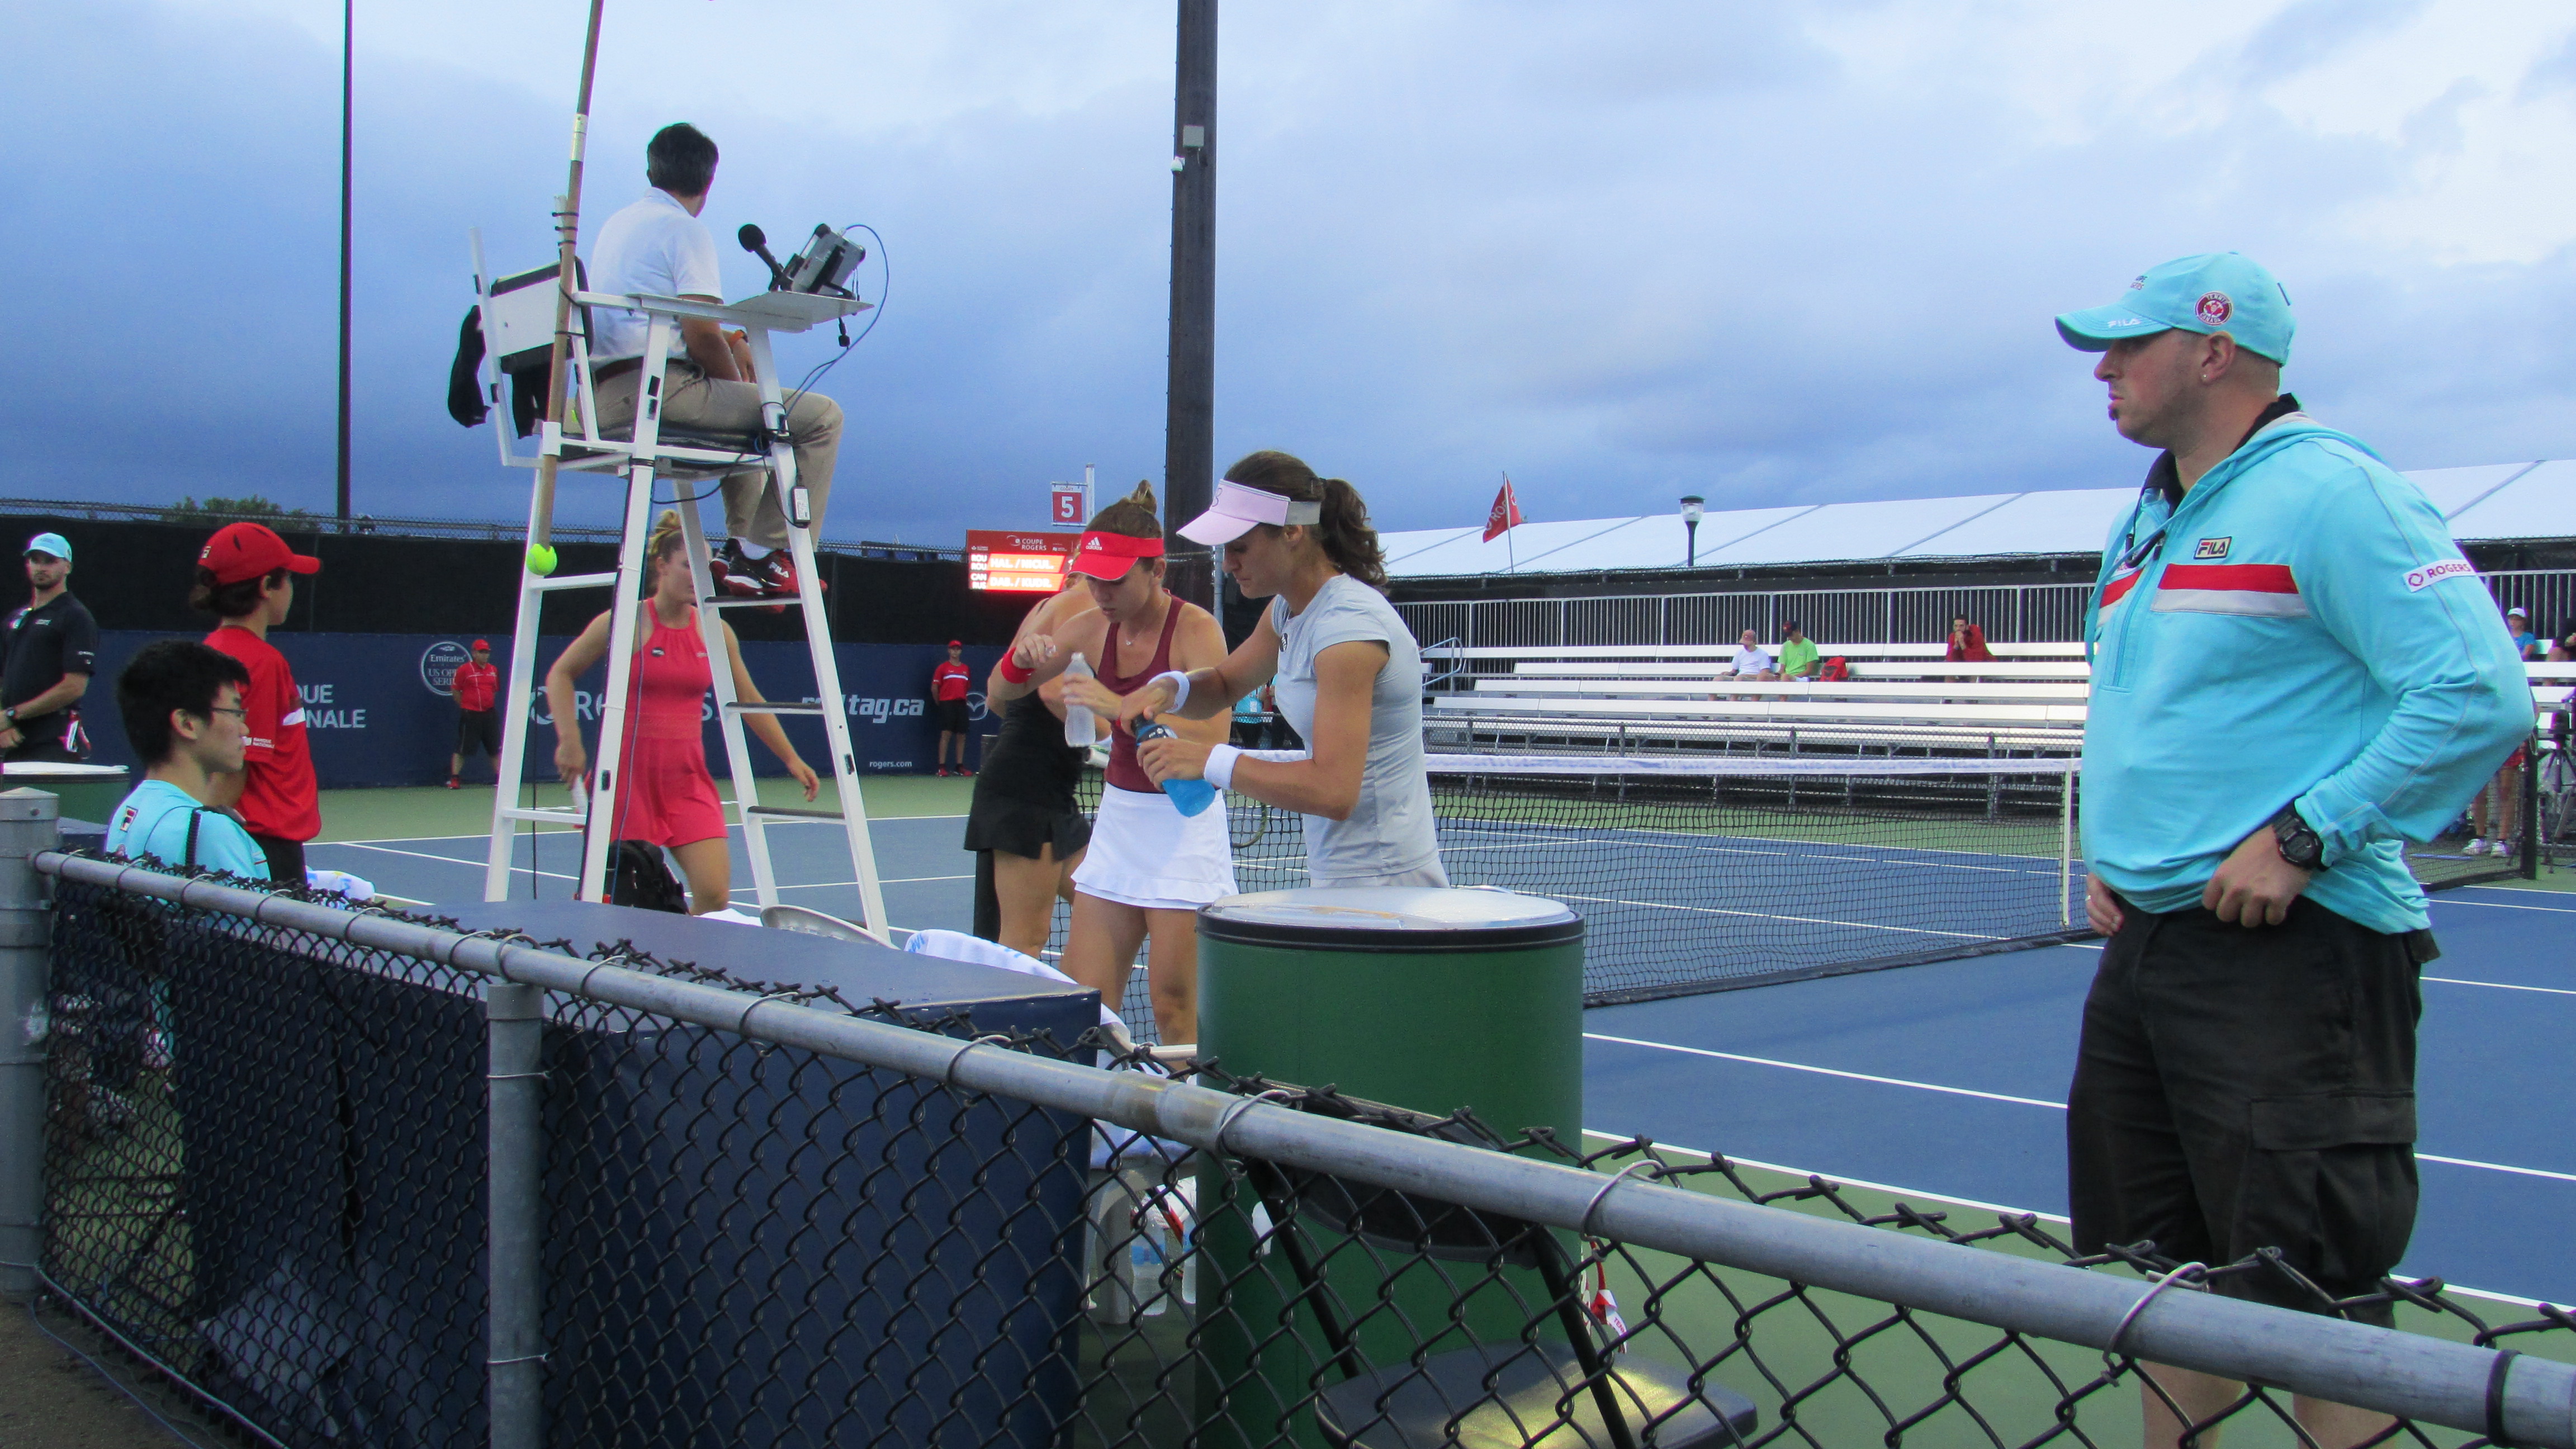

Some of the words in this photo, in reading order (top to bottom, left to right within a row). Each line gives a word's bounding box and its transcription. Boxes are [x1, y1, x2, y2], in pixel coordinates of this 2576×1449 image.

[2108, 318, 2142, 329] FILA
[1061, 496, 1074, 518] 5
[2198, 542, 2226, 555] FILA
[970, 554, 988, 562] ROU
[1021, 559, 1054, 569] NICUL.
[769, 561, 790, 578] FILA
[2426, 564, 2471, 578] ROGERS
[296, 684, 334, 704] UE
[869, 760, 912, 769] rogers.com
